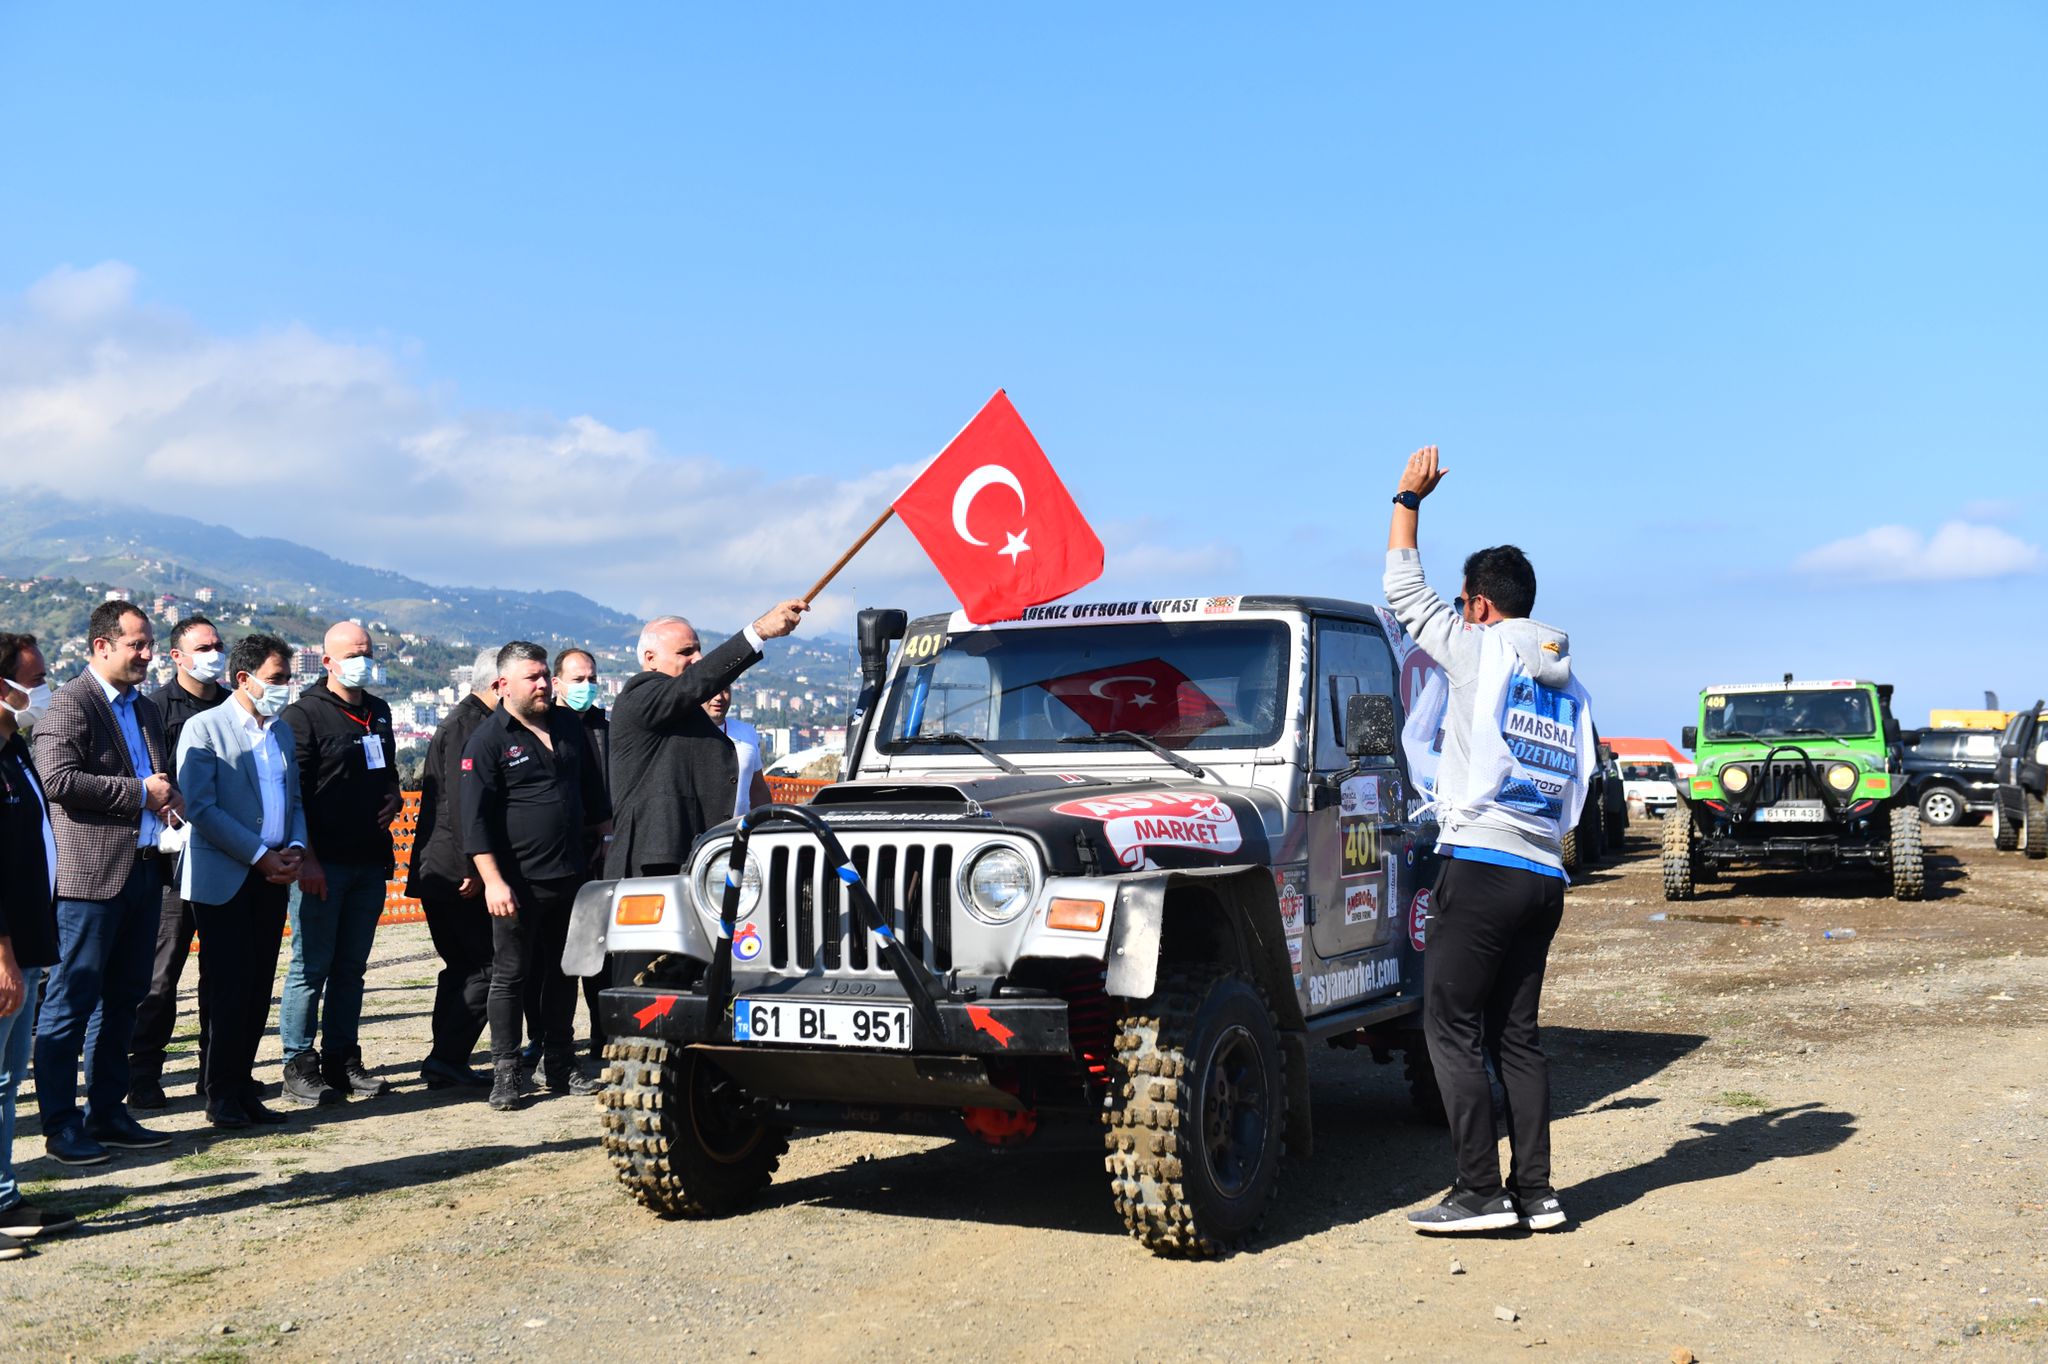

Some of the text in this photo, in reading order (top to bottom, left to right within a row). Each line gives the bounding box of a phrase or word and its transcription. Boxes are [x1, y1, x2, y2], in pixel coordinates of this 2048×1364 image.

[1000, 604, 1069, 624] ADENIZ
[1072, 601, 1138, 618] OFFROAD
[1141, 598, 1199, 615] KUPASI
[905, 633, 941, 658] 401
[1707, 695, 1726, 708] 409
[1510, 712, 1576, 748] MARSHAL
[1079, 792, 1210, 817] ASYA
[1767, 809, 1778, 817] 61
[1800, 809, 1821, 817] 435
[1133, 818, 1218, 845] MARKET
[1345, 821, 1376, 866] 401
[1413, 892, 1430, 945] ASYA
[821, 979, 877, 997] Jeep
[1309, 957, 1400, 1006] asyamarket.com
[751, 1005, 781, 1038] 61
[799, 1007, 838, 1041] BL
[852, 1009, 906, 1045] 951
